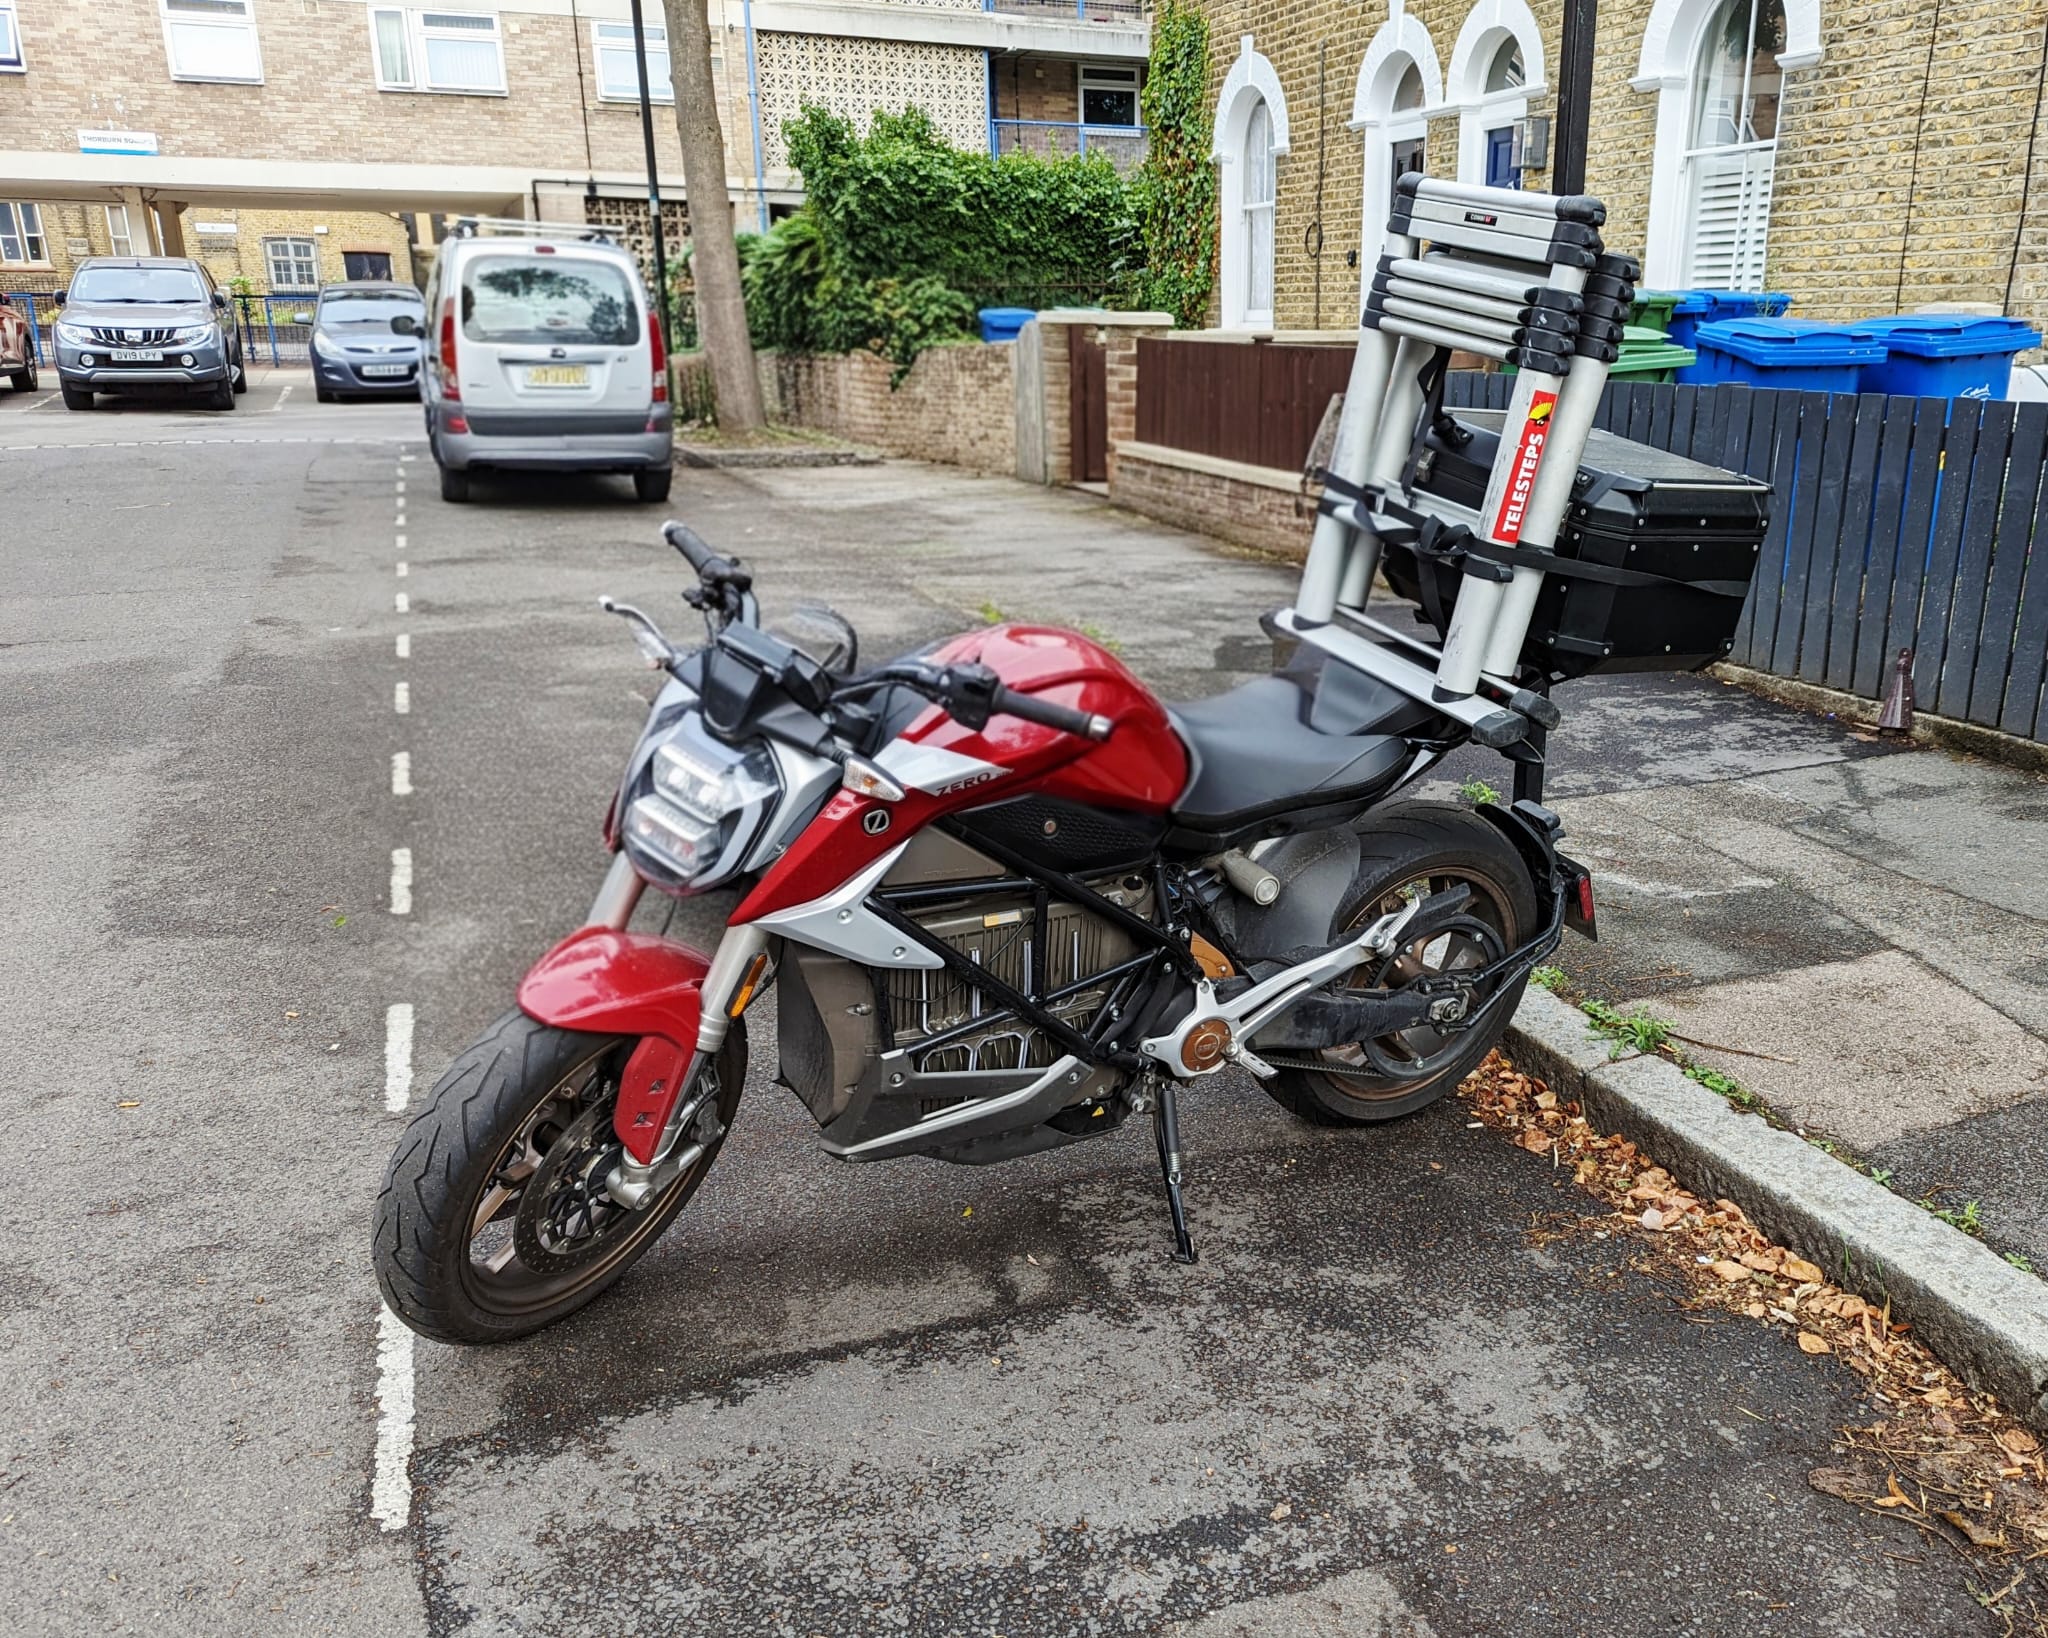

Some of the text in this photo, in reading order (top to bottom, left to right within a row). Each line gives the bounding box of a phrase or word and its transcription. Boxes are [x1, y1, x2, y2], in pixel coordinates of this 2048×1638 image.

[82, 135, 123, 144] THORBURN
[116, 351, 157, 360] DV19 LPY
[1502, 433, 1544, 533] TELESTEPS
[936, 772, 991, 796] ZERO
